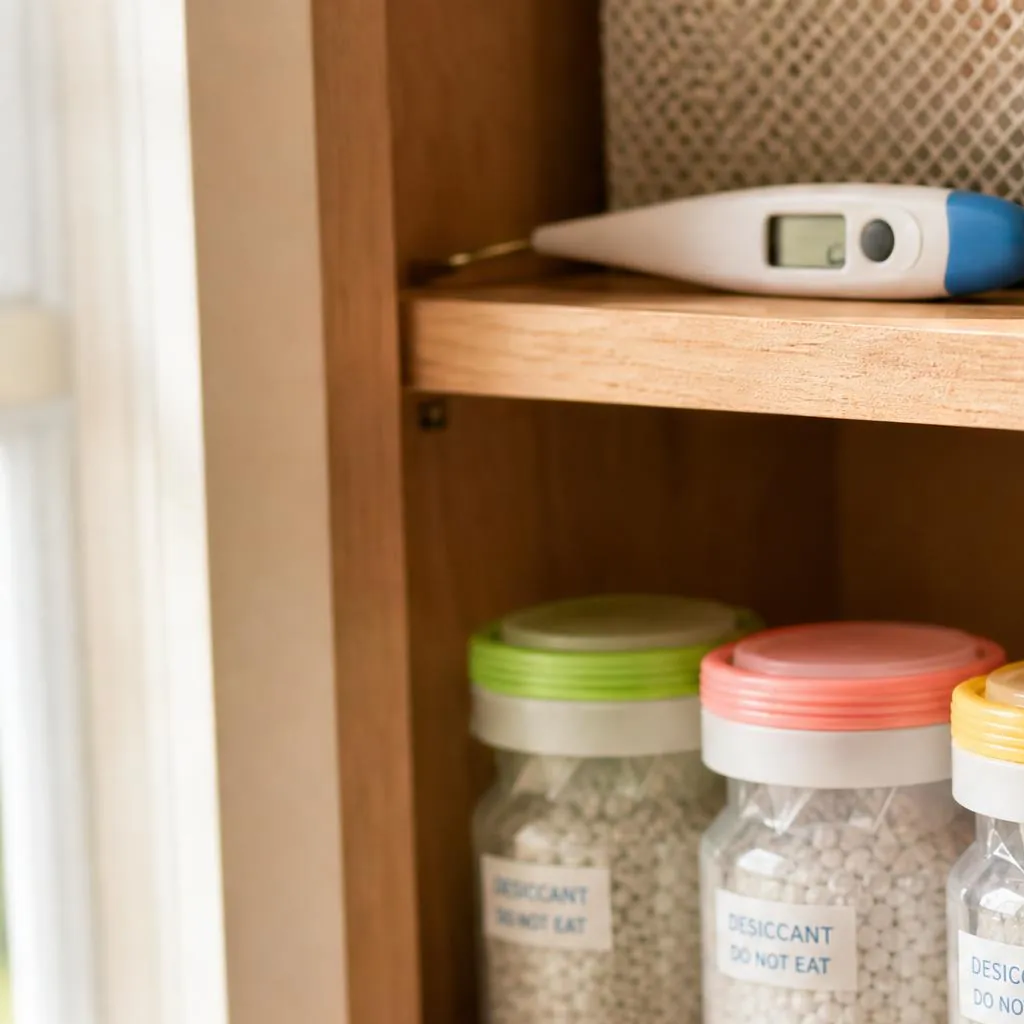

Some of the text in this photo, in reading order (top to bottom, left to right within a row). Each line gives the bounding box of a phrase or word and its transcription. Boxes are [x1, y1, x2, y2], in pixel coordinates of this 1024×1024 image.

[729, 912, 834, 945] DESICCANT
[731, 944, 830, 974] DO NOT EAT
[973, 987, 994, 1009] DO
